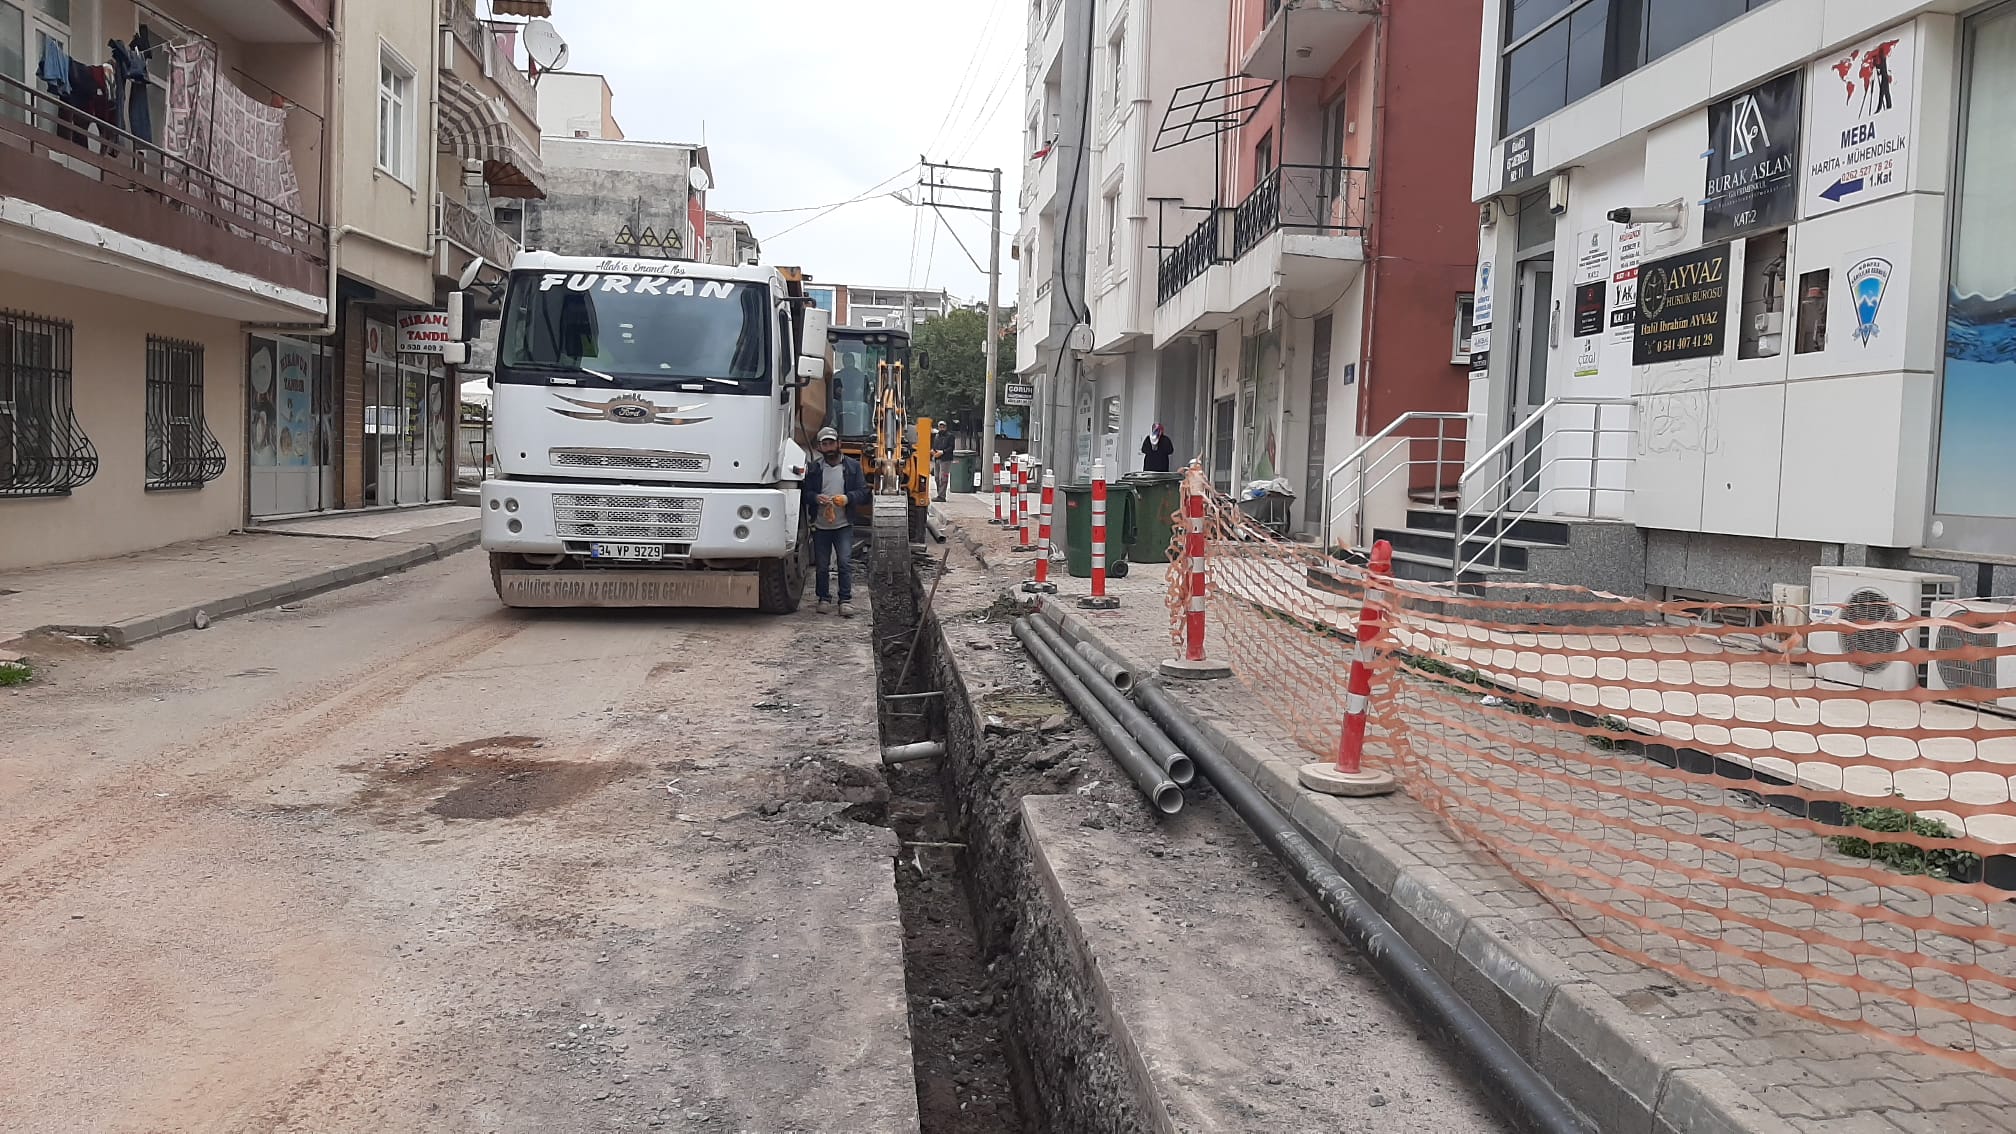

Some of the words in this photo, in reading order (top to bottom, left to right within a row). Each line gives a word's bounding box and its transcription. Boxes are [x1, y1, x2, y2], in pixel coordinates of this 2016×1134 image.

[1841, 121, 1876, 149] MEBA
[1811, 156, 1841, 176] HARİTA
[1847, 135, 1906, 165] MÜHENDİSLİK
[1707, 167, 1748, 196] BURAK
[1750, 152, 1793, 182] ASLAN
[1841, 169, 1858, 181] 0262
[1859, 165, 1872, 177] 527
[1874, 161, 1883, 172] 78
[1884, 158, 1893, 170] 26
[1869, 170, 1892, 187] 1.Kat
[1733, 209, 1757, 228] KAT:2
[1668, 257, 1723, 291] AYVAZ
[539, 273, 736, 299] FURKAN
[1666, 293, 1691, 307] HUKUK
[1692, 286, 1723, 302] BÜROSU
[399, 313, 449, 329] HİRANU
[1641, 321, 1658, 336] Halil
[1690, 311, 1718, 327] AYVAZ
[1657, 340, 1661, 353] 0
[1663, 338, 1675, 352] 541
[1677, 336, 1690, 350] 407
[1692, 335, 1701, 347] 41
[1703, 333, 1713, 346] 29
[618, 406, 641, 417] Ford
[599, 545, 611, 556] 34
[617, 545, 630, 557] VP
[634, 546, 661, 557] 9229
